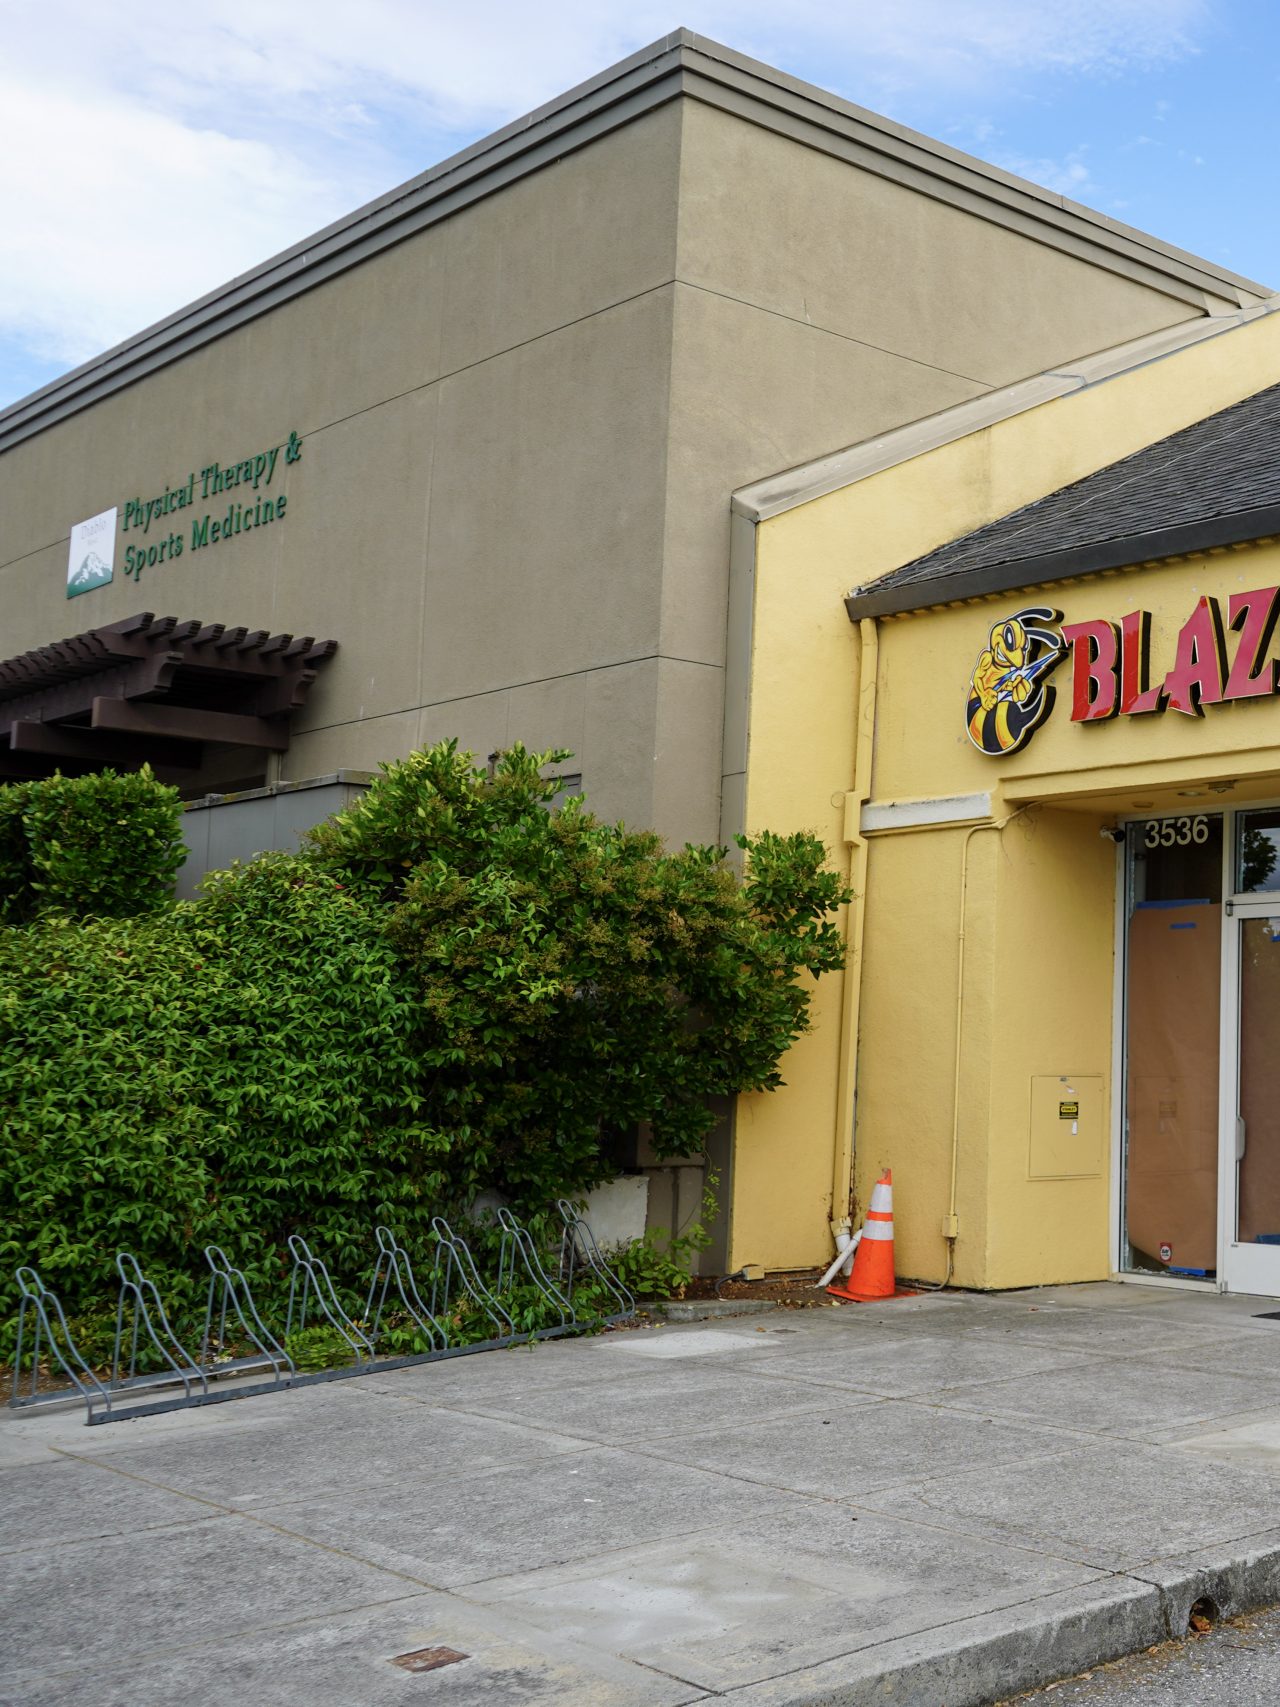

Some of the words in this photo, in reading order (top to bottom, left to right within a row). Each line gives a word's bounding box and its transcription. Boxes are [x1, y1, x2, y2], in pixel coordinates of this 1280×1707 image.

[122, 473, 195, 533] Physical
[200, 447, 279, 499] Therapy
[284, 431, 302, 464] &
[123, 533, 184, 582] Sports
[190, 495, 288, 551] Medicine
[1145, 815, 1209, 848] 3536
